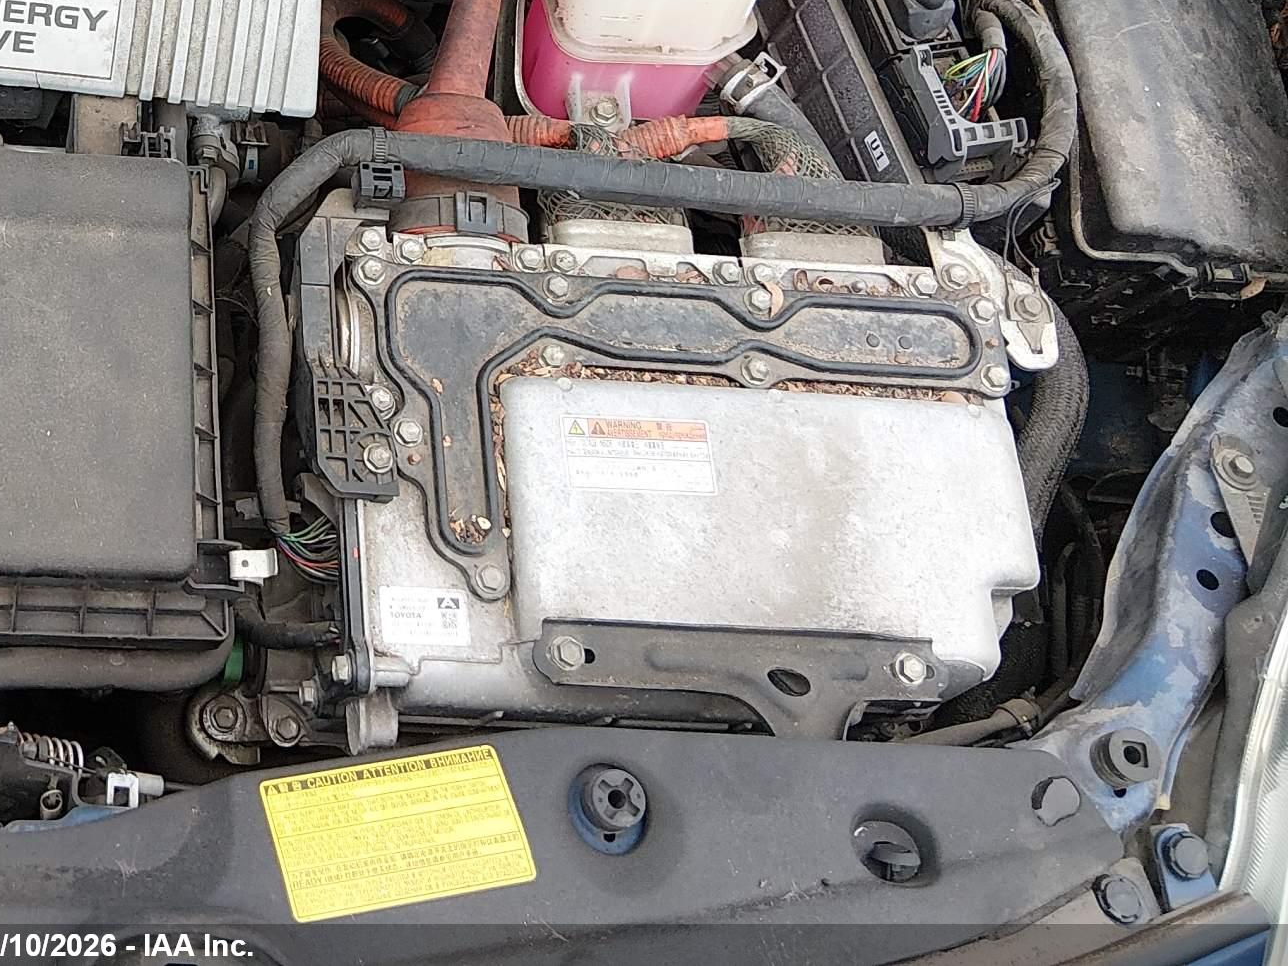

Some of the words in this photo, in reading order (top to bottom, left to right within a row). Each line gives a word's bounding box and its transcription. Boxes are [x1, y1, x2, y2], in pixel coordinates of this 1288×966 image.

[870, 137, 885, 161] U1
[606, 420, 642, 430] WARNING
[307, 771, 358, 788] CAUTION
[362, 760, 426, 780] ATTENTION
[431, 749, 492, 769] ВНИМАНИЕ
